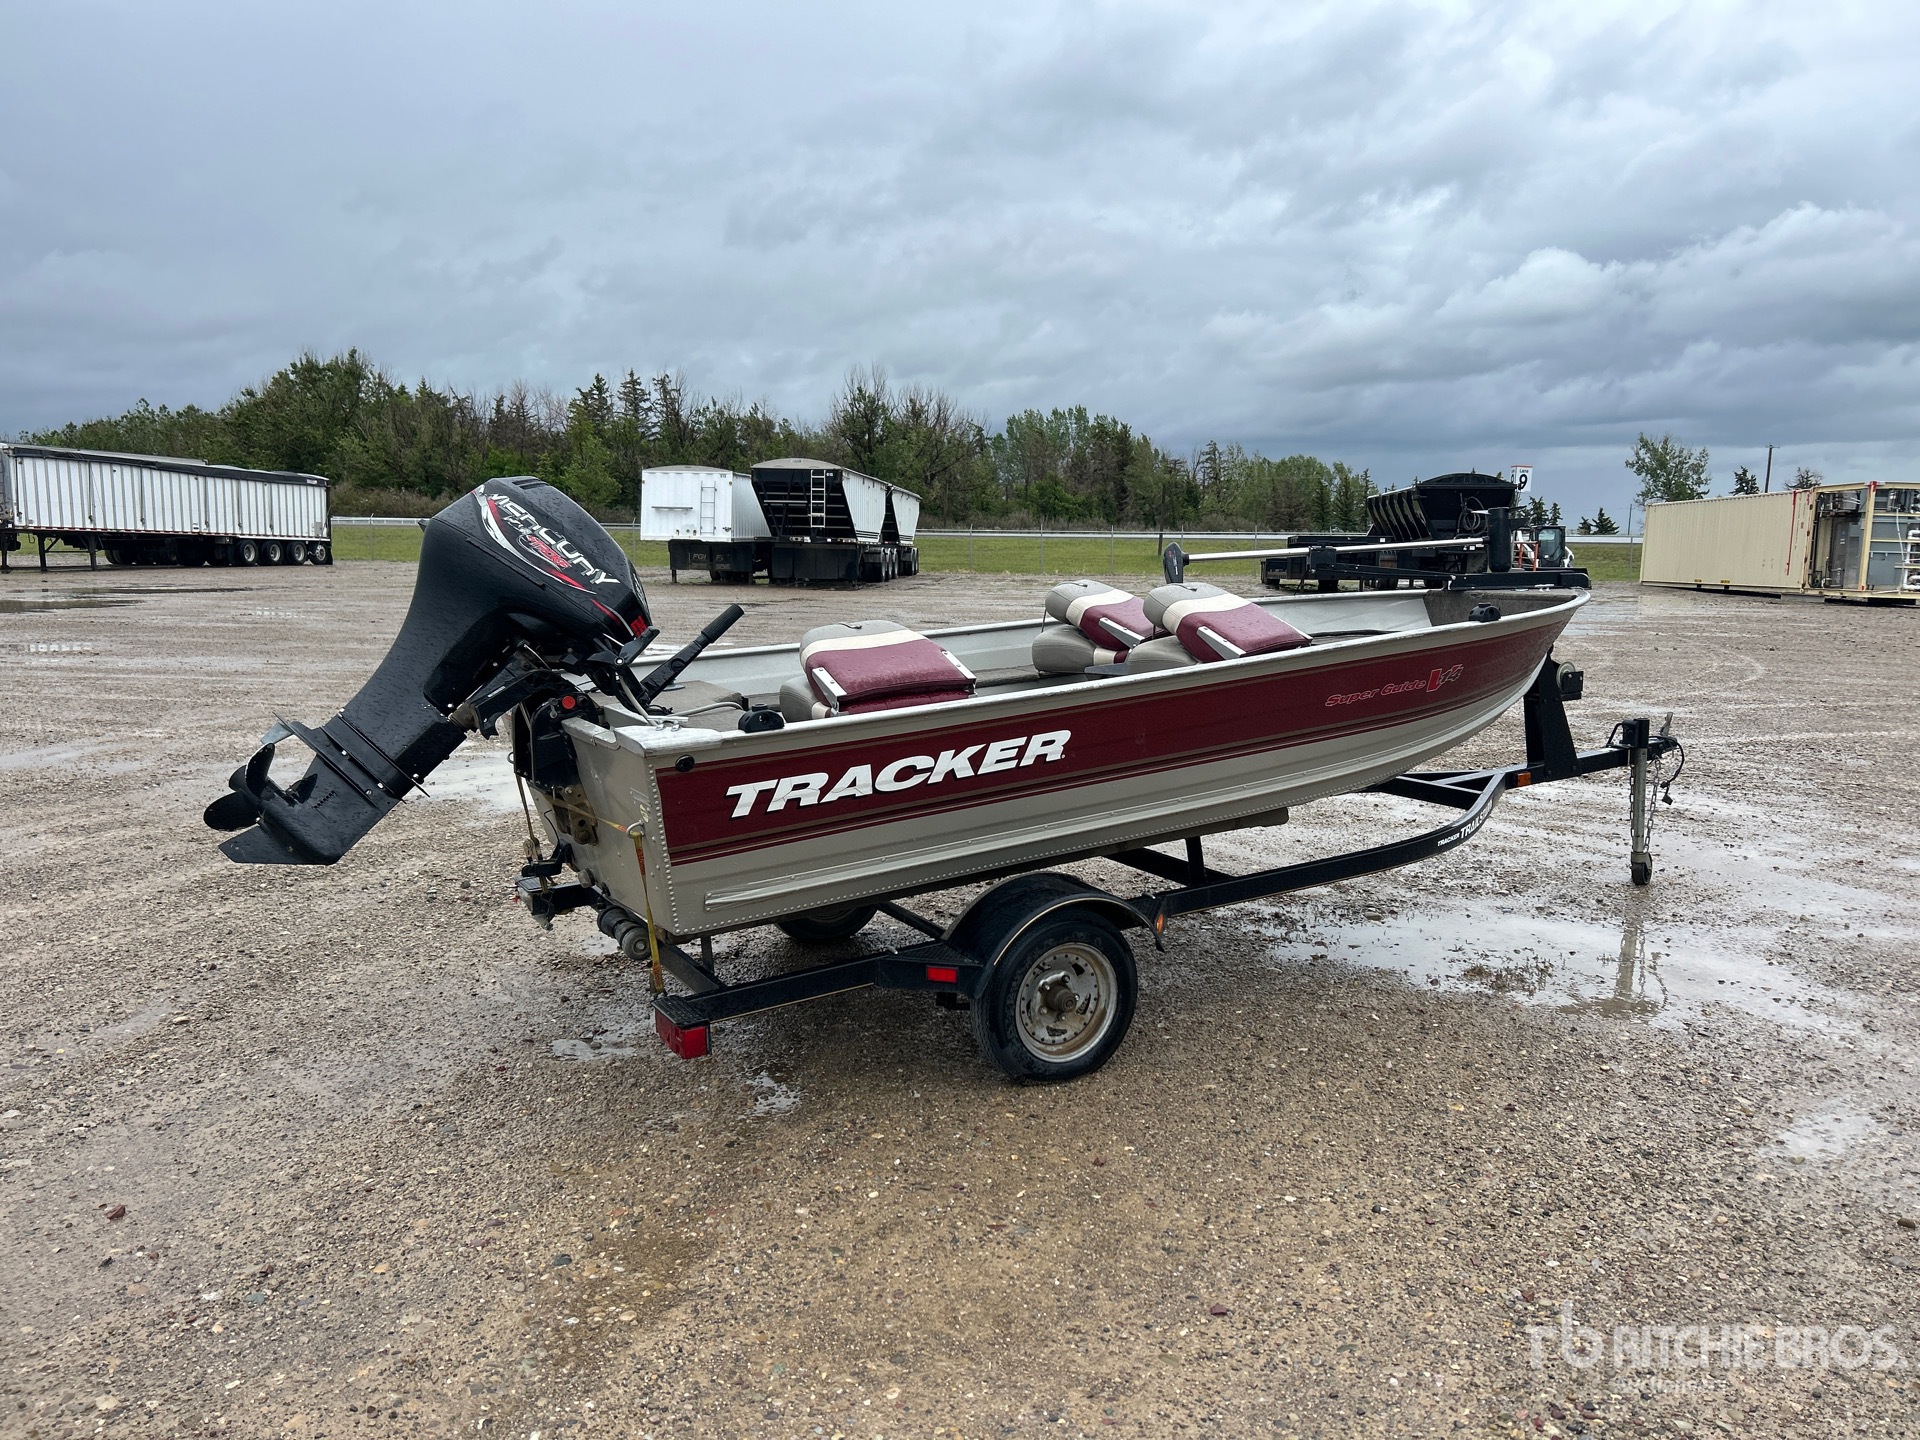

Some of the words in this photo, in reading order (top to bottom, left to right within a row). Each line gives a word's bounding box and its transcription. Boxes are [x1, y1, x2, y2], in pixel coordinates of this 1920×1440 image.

[1518, 474, 1528, 490] 9
[485, 493, 620, 585] MERCURY
[1324, 689, 1380, 706] Super
[1380, 680, 1426, 695] Guide
[1426, 663, 1464, 692] V14
[725, 730, 1070, 818] TRACKER
